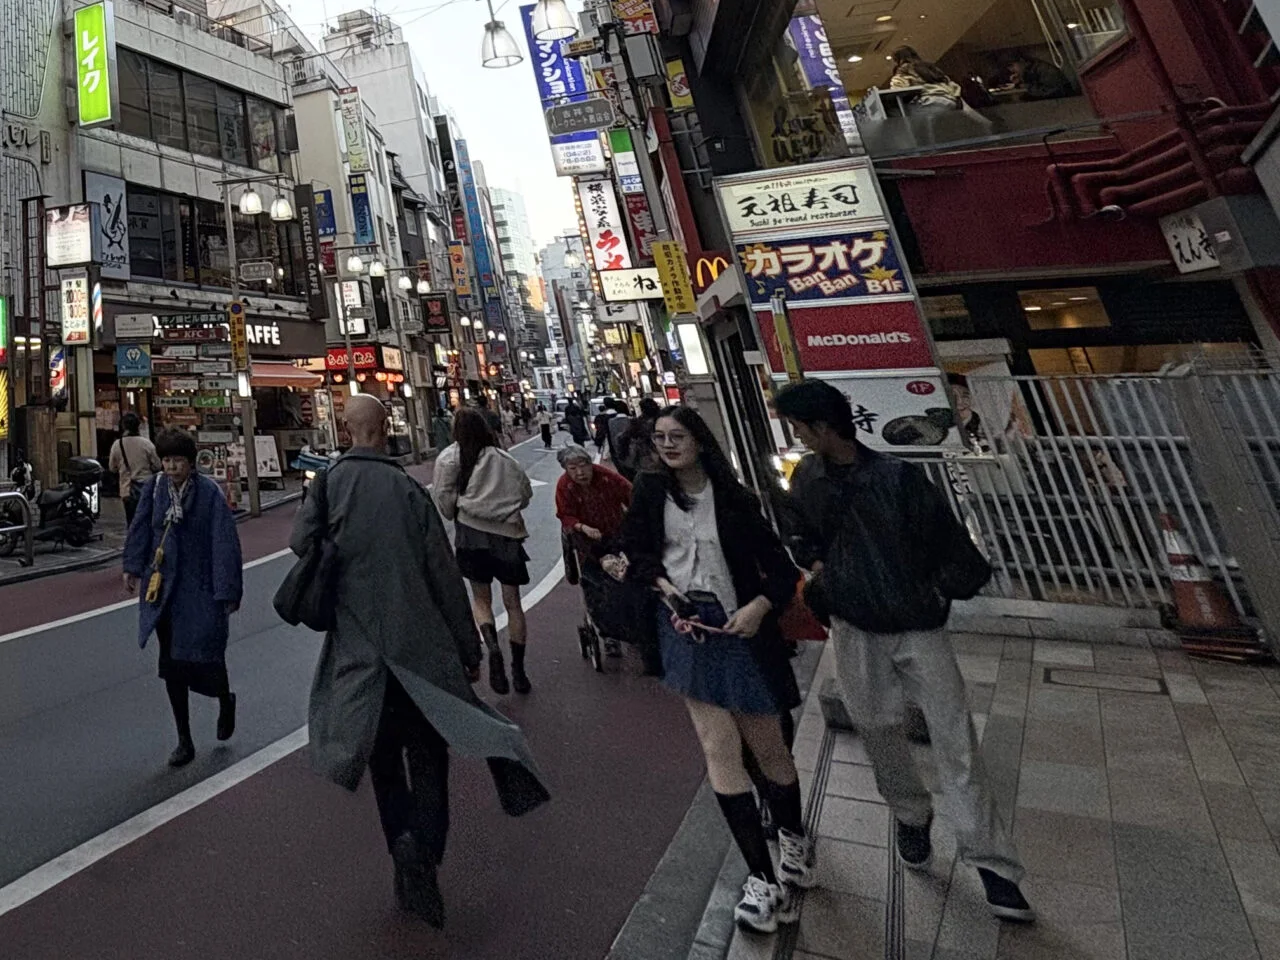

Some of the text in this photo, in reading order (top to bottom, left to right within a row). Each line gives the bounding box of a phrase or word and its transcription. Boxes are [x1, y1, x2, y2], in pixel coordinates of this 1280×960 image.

[81, 30, 102, 93] レイク
[736, 184, 860, 218] 元祖寿司
[300, 206, 315, 260] EXCELSIOR
[745, 239, 888, 277] カラオケ
[789, 269, 859, 295] Ban Ban
[865, 279, 904, 294] B1F
[184, 330, 204, 338] KFC
[245, 322, 281, 345] AFFÉ
[807, 331, 913, 347] McDonald's
